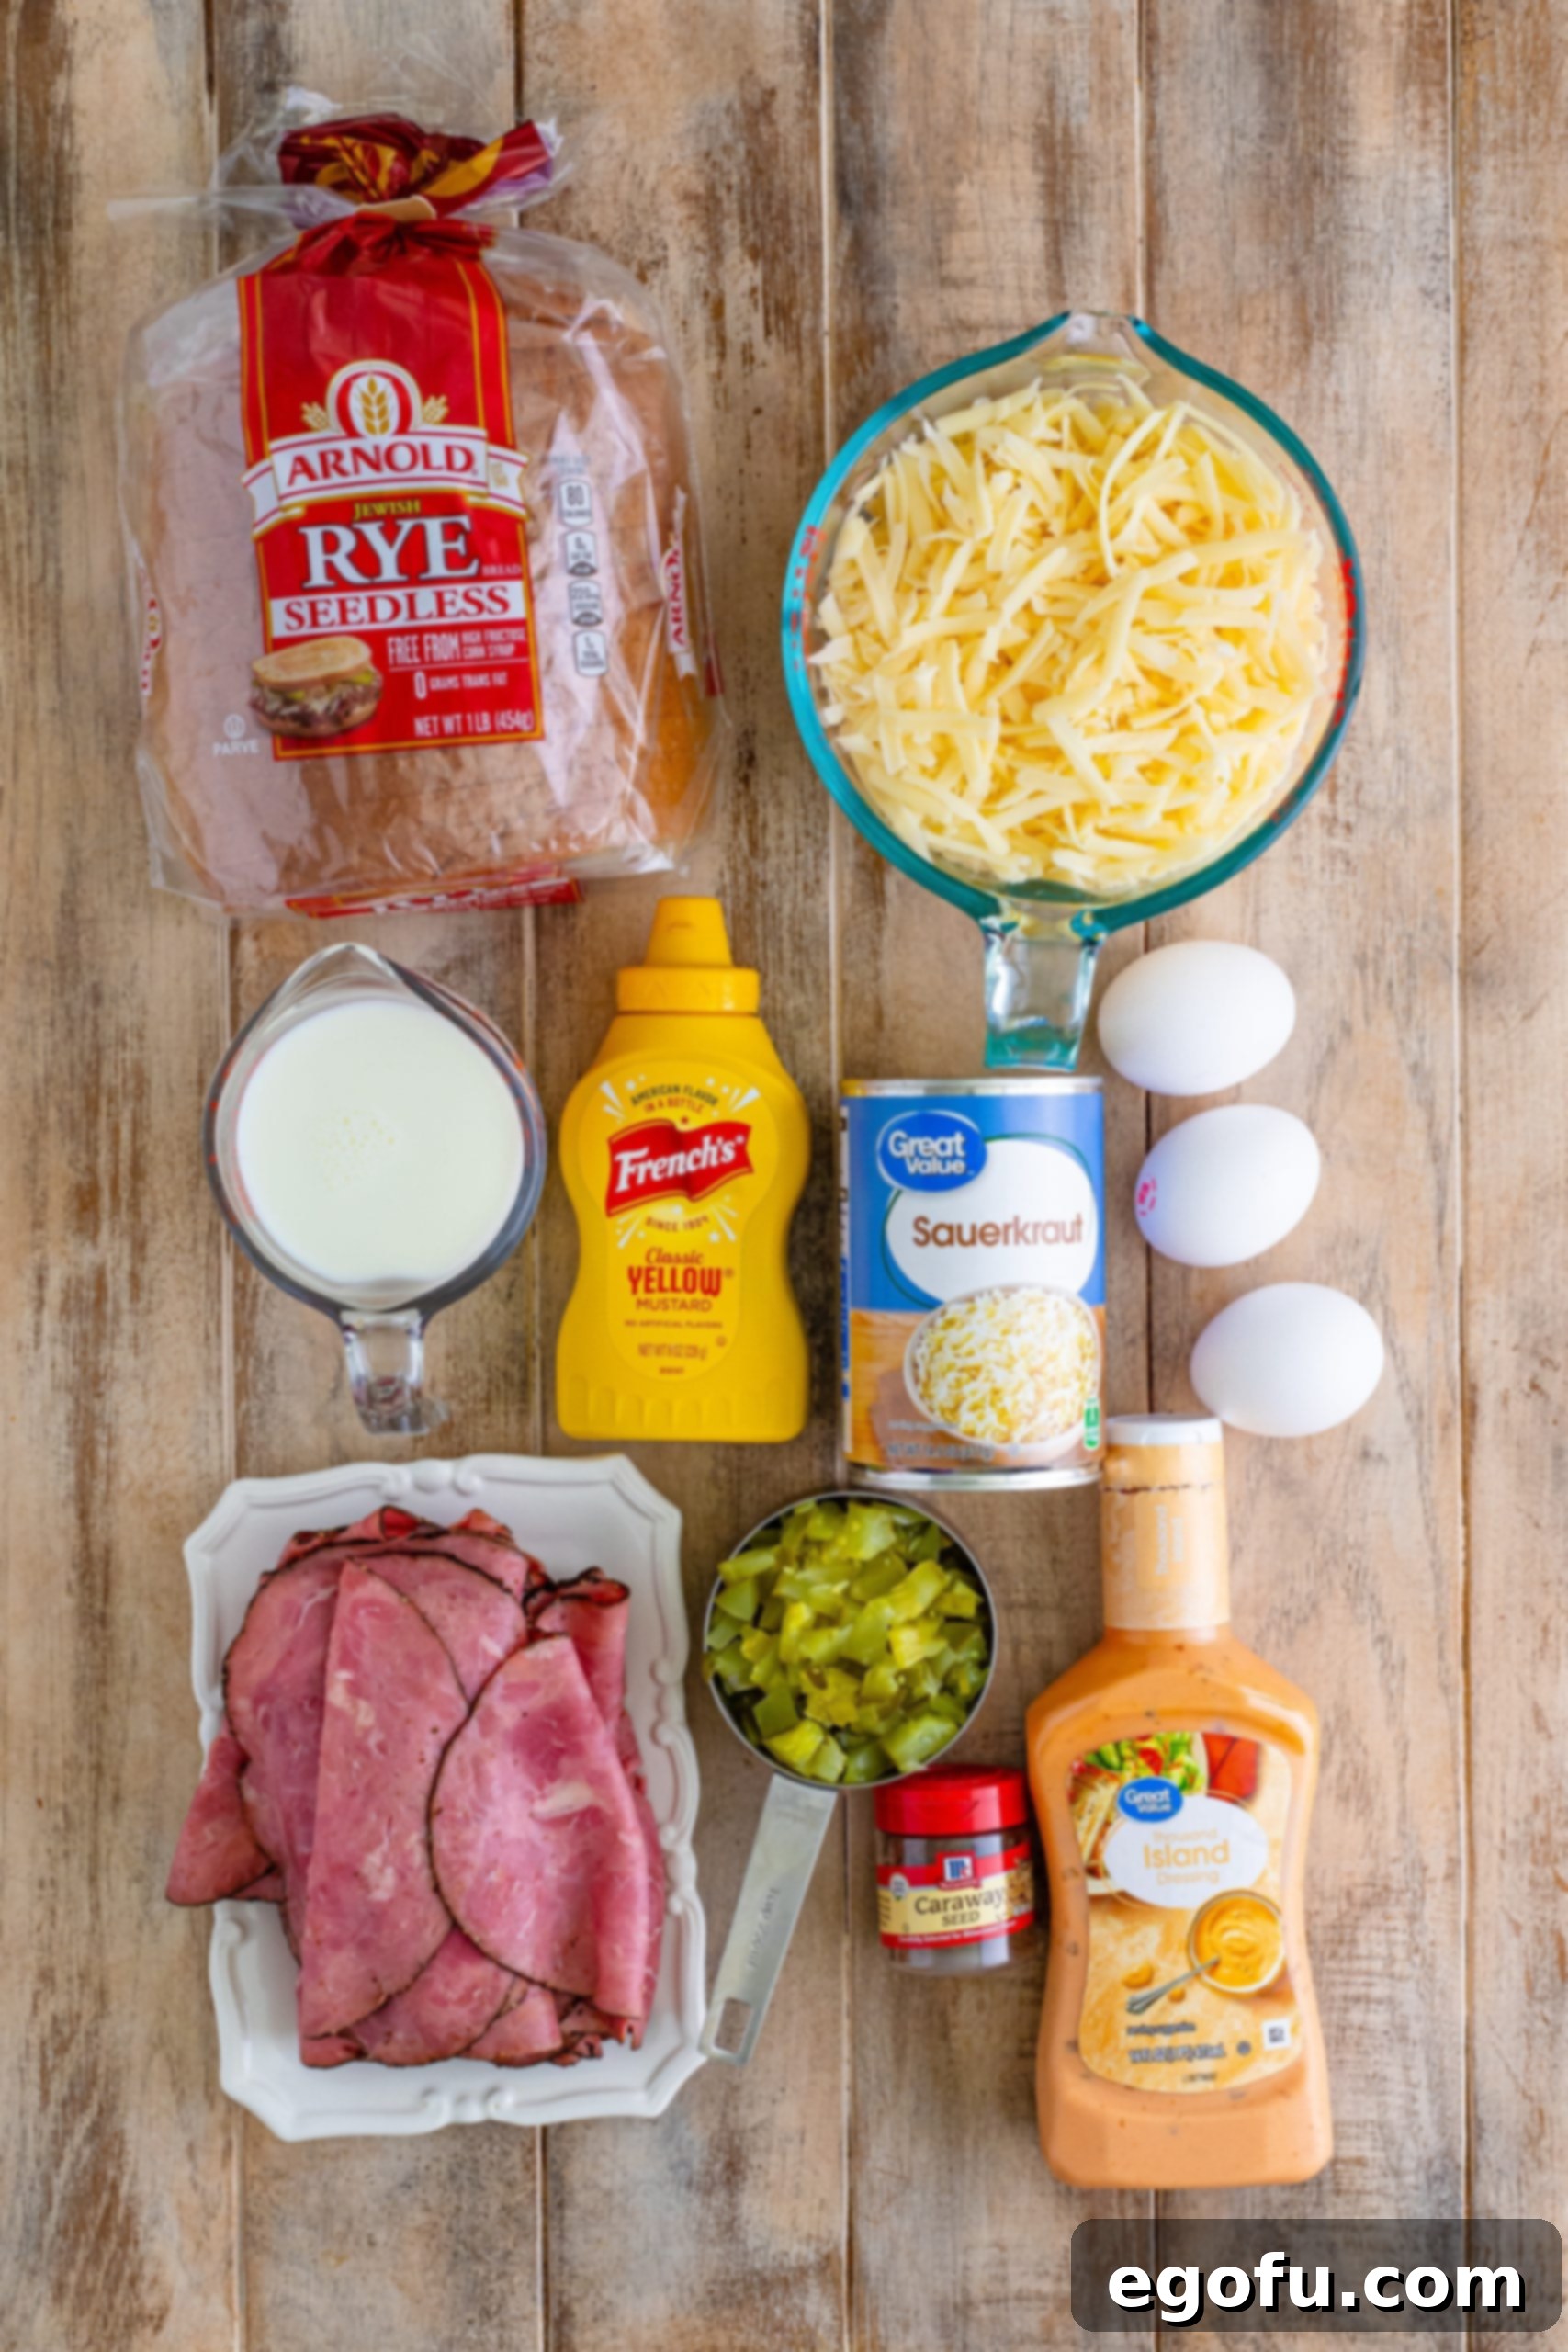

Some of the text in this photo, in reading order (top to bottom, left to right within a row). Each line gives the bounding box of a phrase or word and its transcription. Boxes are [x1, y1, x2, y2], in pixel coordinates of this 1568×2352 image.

[288, 441, 476, 487] ARNOLD
[355, 499, 421, 520] JEWISH
[299, 514, 479, 587] RYE
[284, 585, 510, 632] SEEDLESS
[387, 631, 460, 666] FREE FROM
[414, 671, 428, 700] 0
[414, 715, 439, 737] NET
[441, 712, 464, 735] WT
[466, 711, 473, 733] 1
[474, 710, 491, 734] LB
[212, 739, 260, 757] PARVE
[630, 1083, 681, 1106] AMERICAN
[887, 1129, 967, 1158] Great
[904, 1158, 967, 1176] Value
[911, 1212, 1084, 1248] Sauerkraut
[645, 1246, 705, 1265] Classic
[627, 1265, 722, 1298] YELLOW
[635, 1297, 713, 1313] MUSTARD
[1123, 1787, 1172, 1806] Great
[1143, 1838, 1230, 1869] Island
[914, 1886, 1004, 1916] Caraway
[941, 1910, 980, 1928] SEED
